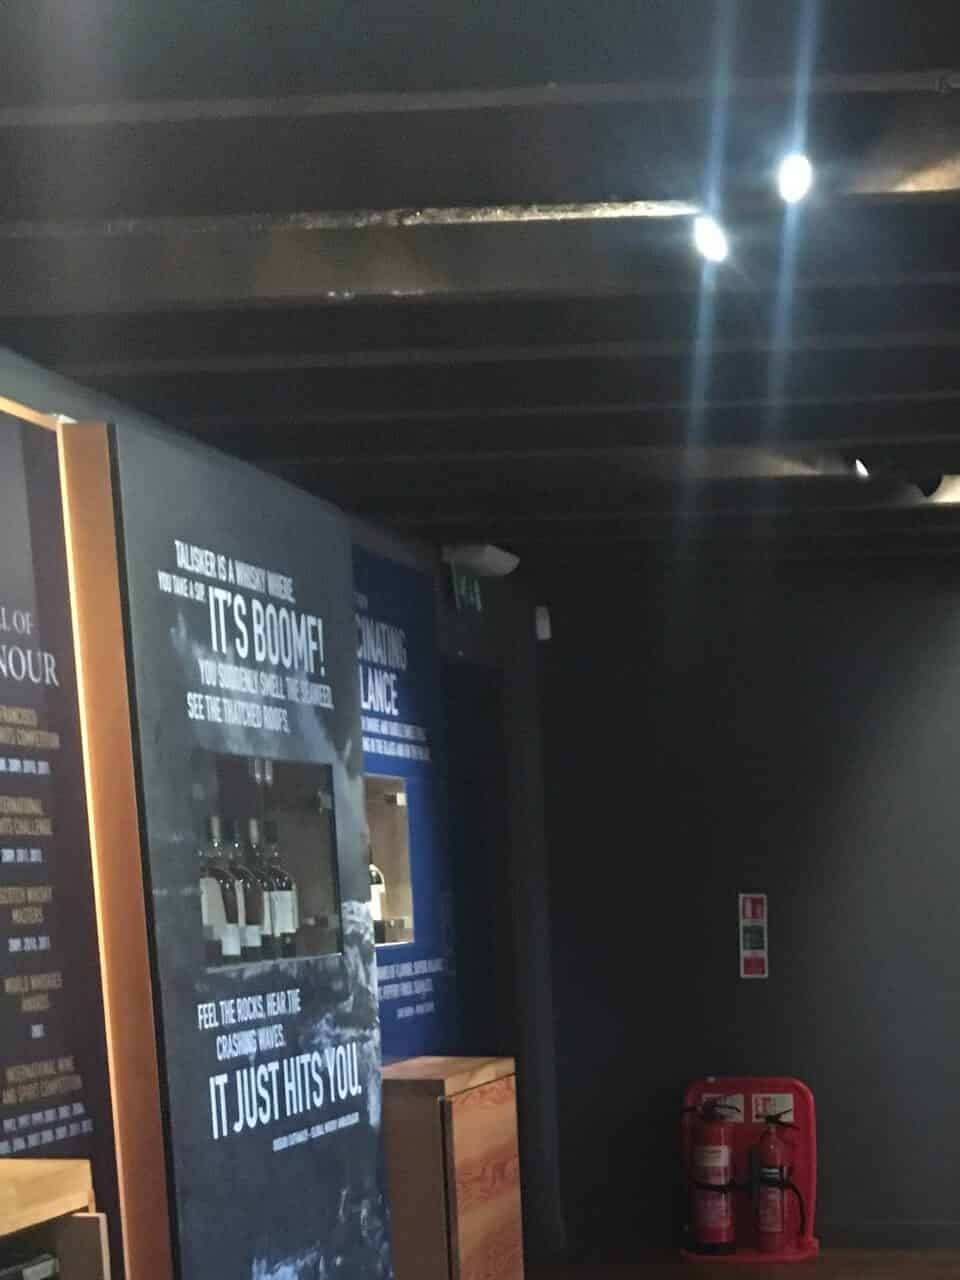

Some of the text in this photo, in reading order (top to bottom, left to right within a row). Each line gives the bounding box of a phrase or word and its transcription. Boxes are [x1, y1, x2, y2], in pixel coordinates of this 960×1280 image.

[217, 553, 227, 582] IS
[227, 557, 235, 584] A
[12, 609, 34, 635] OF
[208, 585, 326, 676] IT'S BOOMF!
[198, 659, 217, 687] YOU
[187, 692, 205, 721] SEE
[197, 1001, 219, 1031] FEEL
[219, 998, 236, 1025] THE
[209, 1073, 229, 1140] IT
[233, 1061, 280, 1133] JUST
[283, 1051, 324, 1117] HITS
[324, 1041, 363, 1103] YOU.
